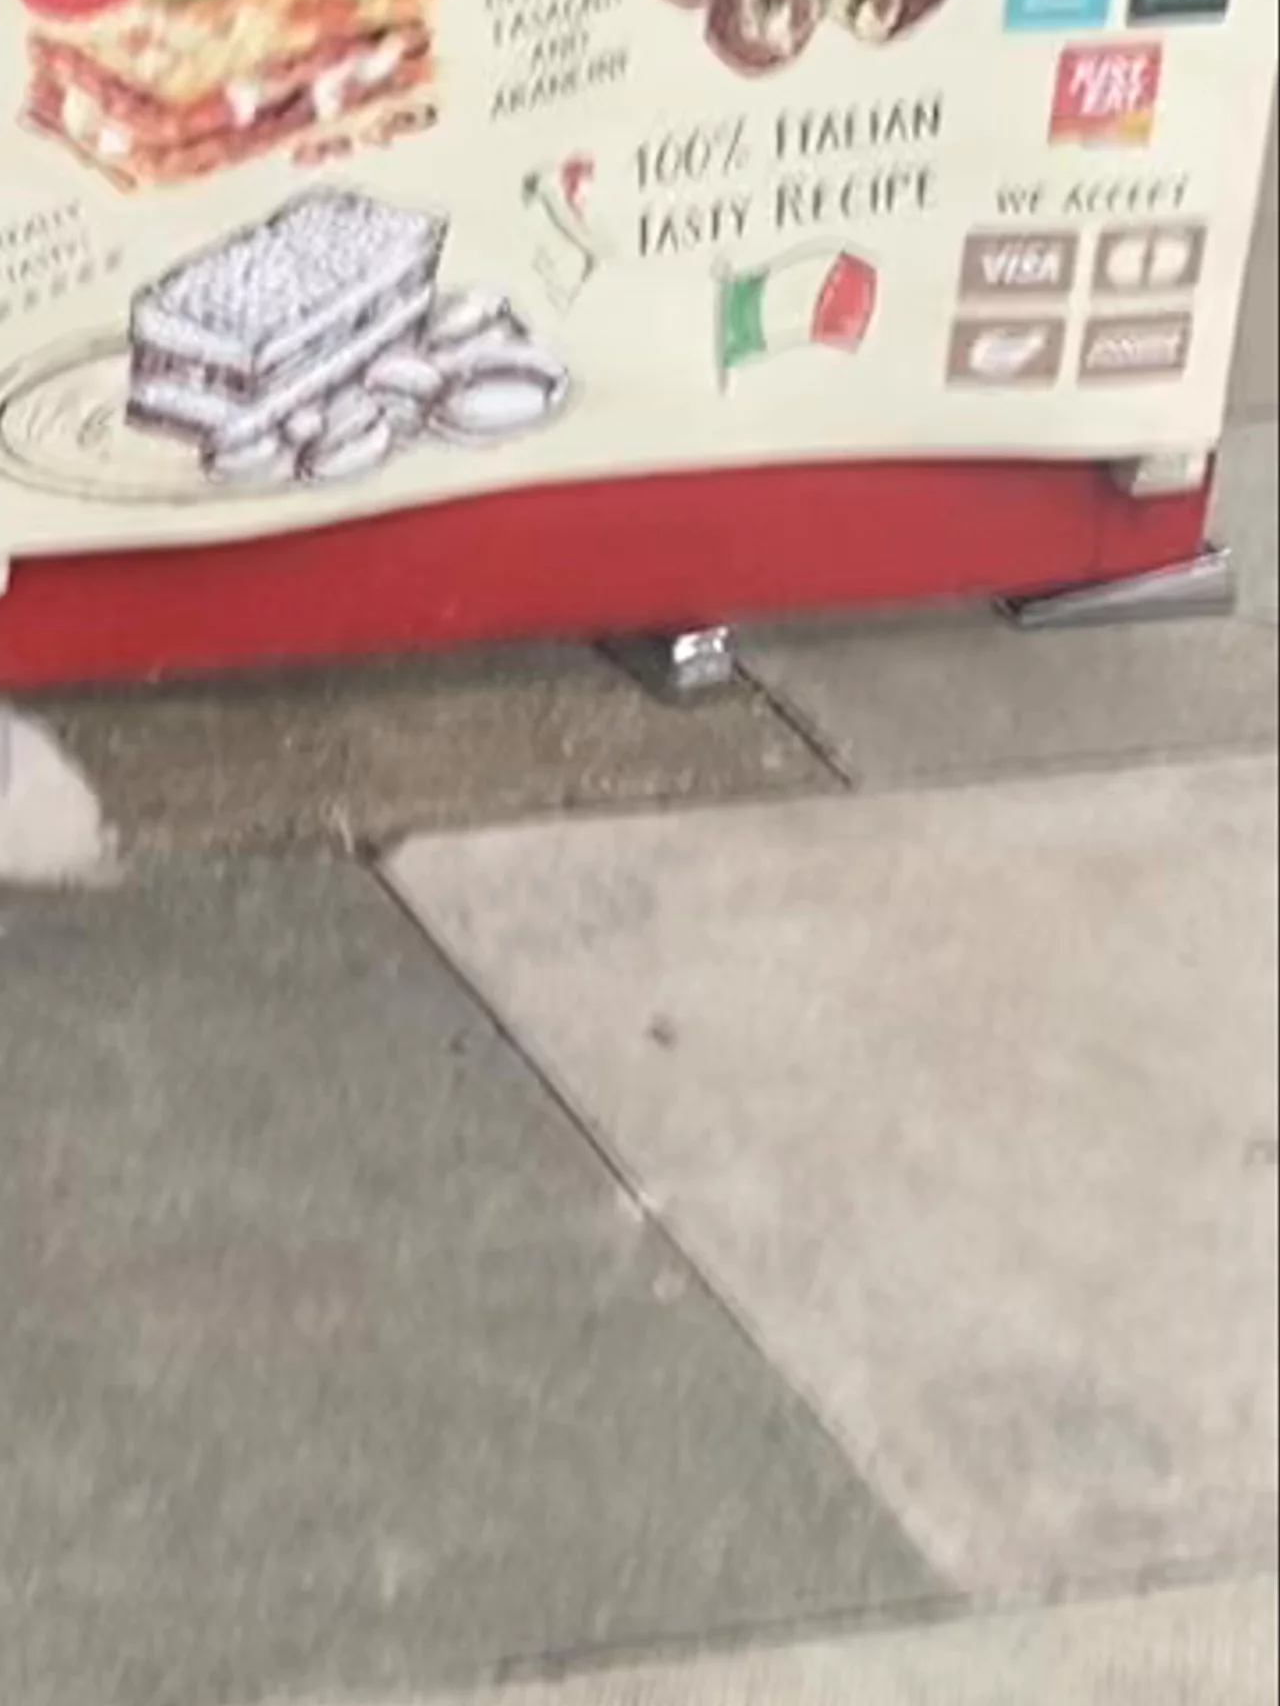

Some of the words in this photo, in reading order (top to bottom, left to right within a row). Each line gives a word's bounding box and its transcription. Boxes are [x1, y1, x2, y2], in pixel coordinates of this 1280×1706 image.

[631, 113, 750, 192] 100%
[774, 88, 944, 160] ITALIAN
[638, 193, 754, 258] TASTY
[774, 162, 932, 230] RECIPE
[981, 240, 1062, 285] VISA
